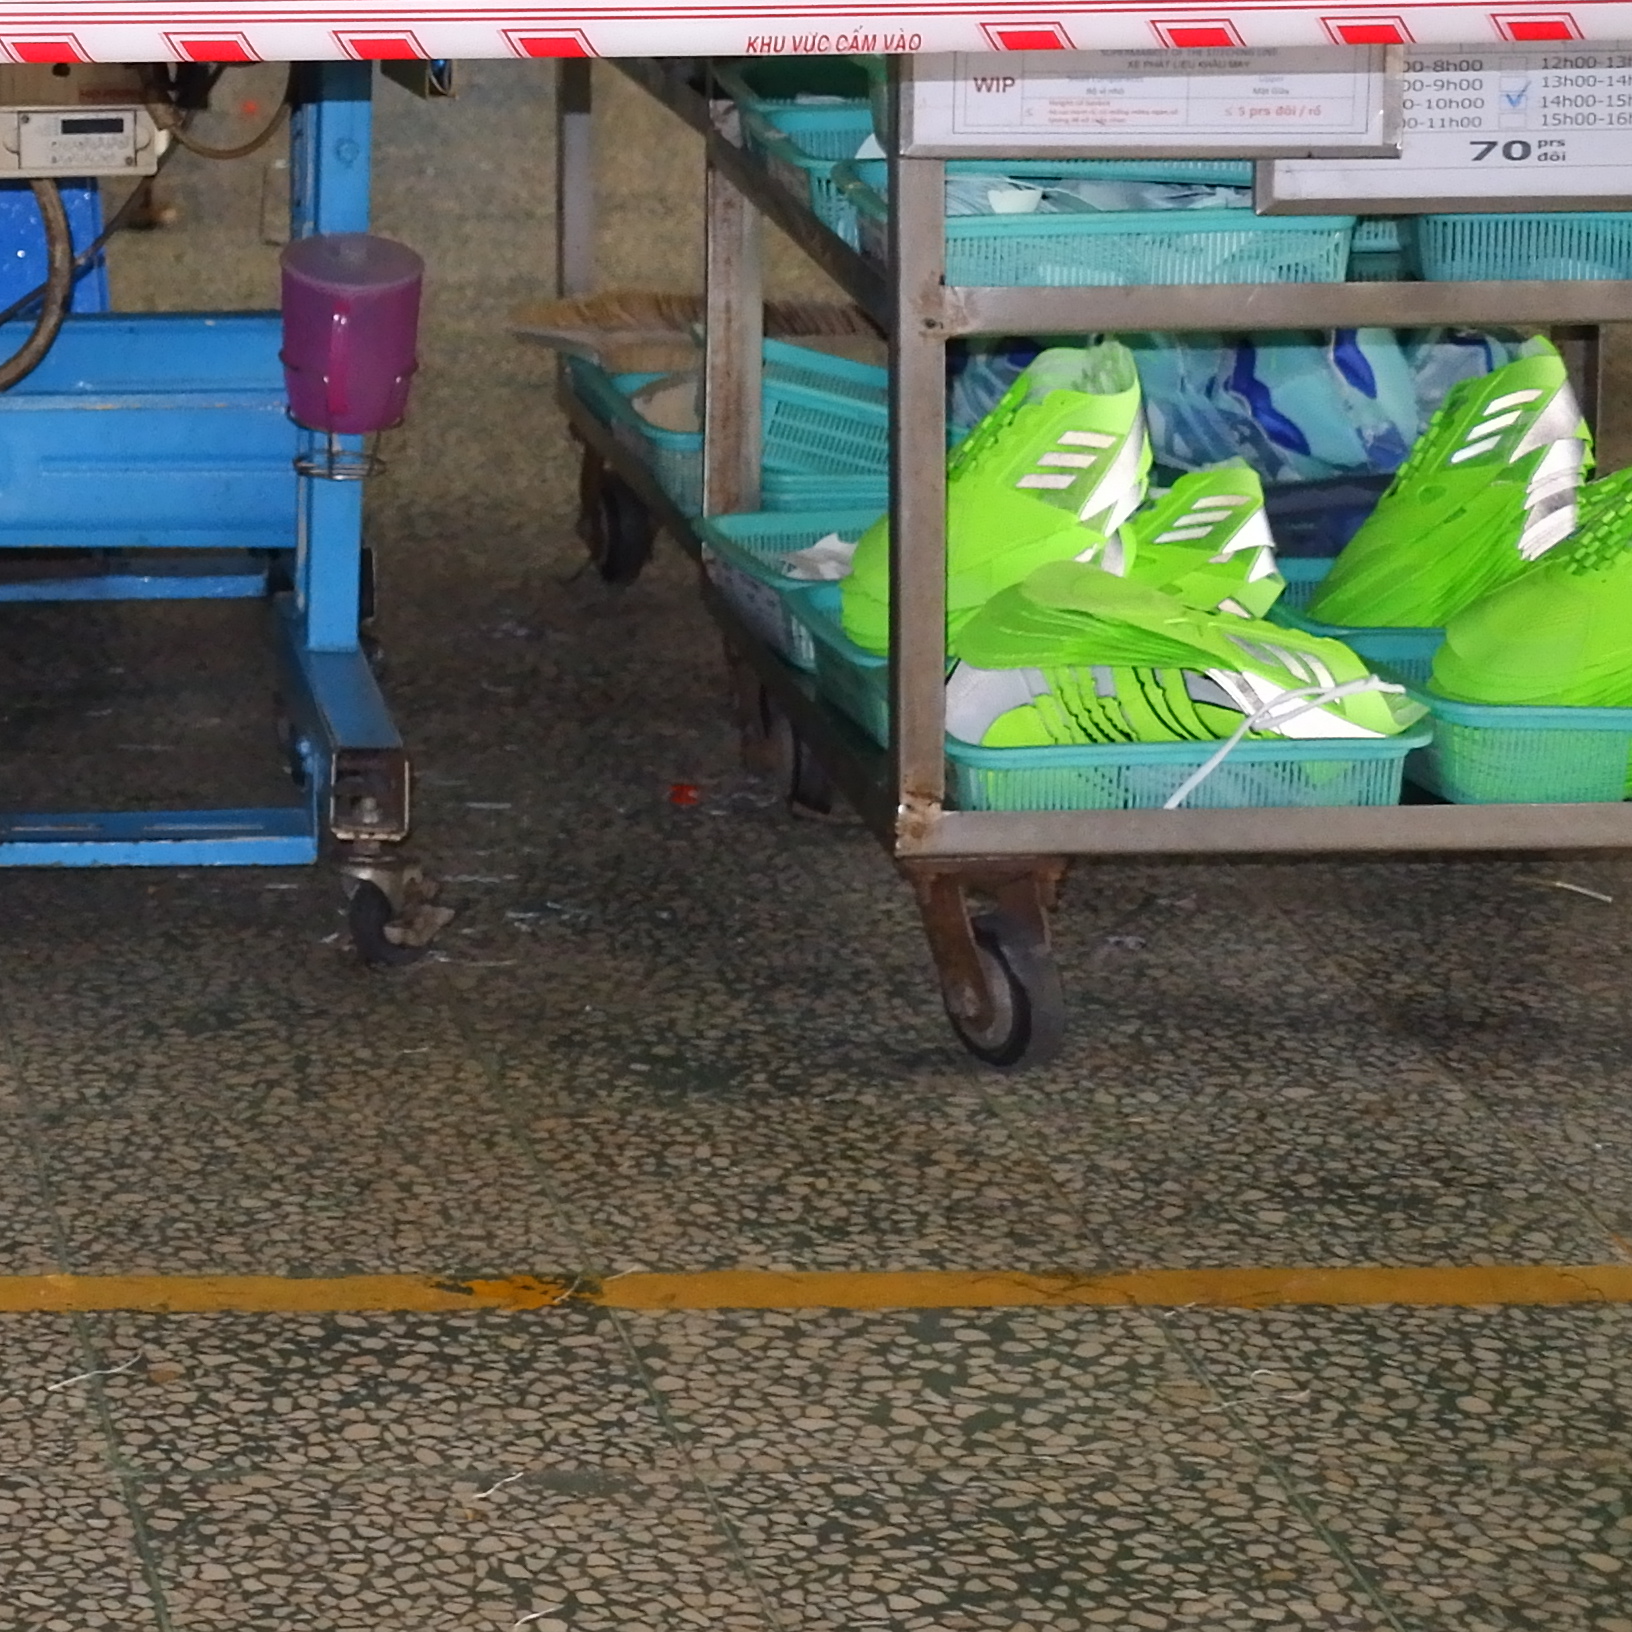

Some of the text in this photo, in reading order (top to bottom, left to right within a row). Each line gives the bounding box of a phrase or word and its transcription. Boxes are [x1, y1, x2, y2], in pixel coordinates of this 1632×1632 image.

[746, 36, 786, 53] KHU
[836, 25, 877, 52] CẤM
[883, 28, 922, 51] VÀO
[974, 77, 1016, 94] WIP
[1469, 139, 1566, 162] 70 prs
[1537, 151, 1566, 162] đôi
